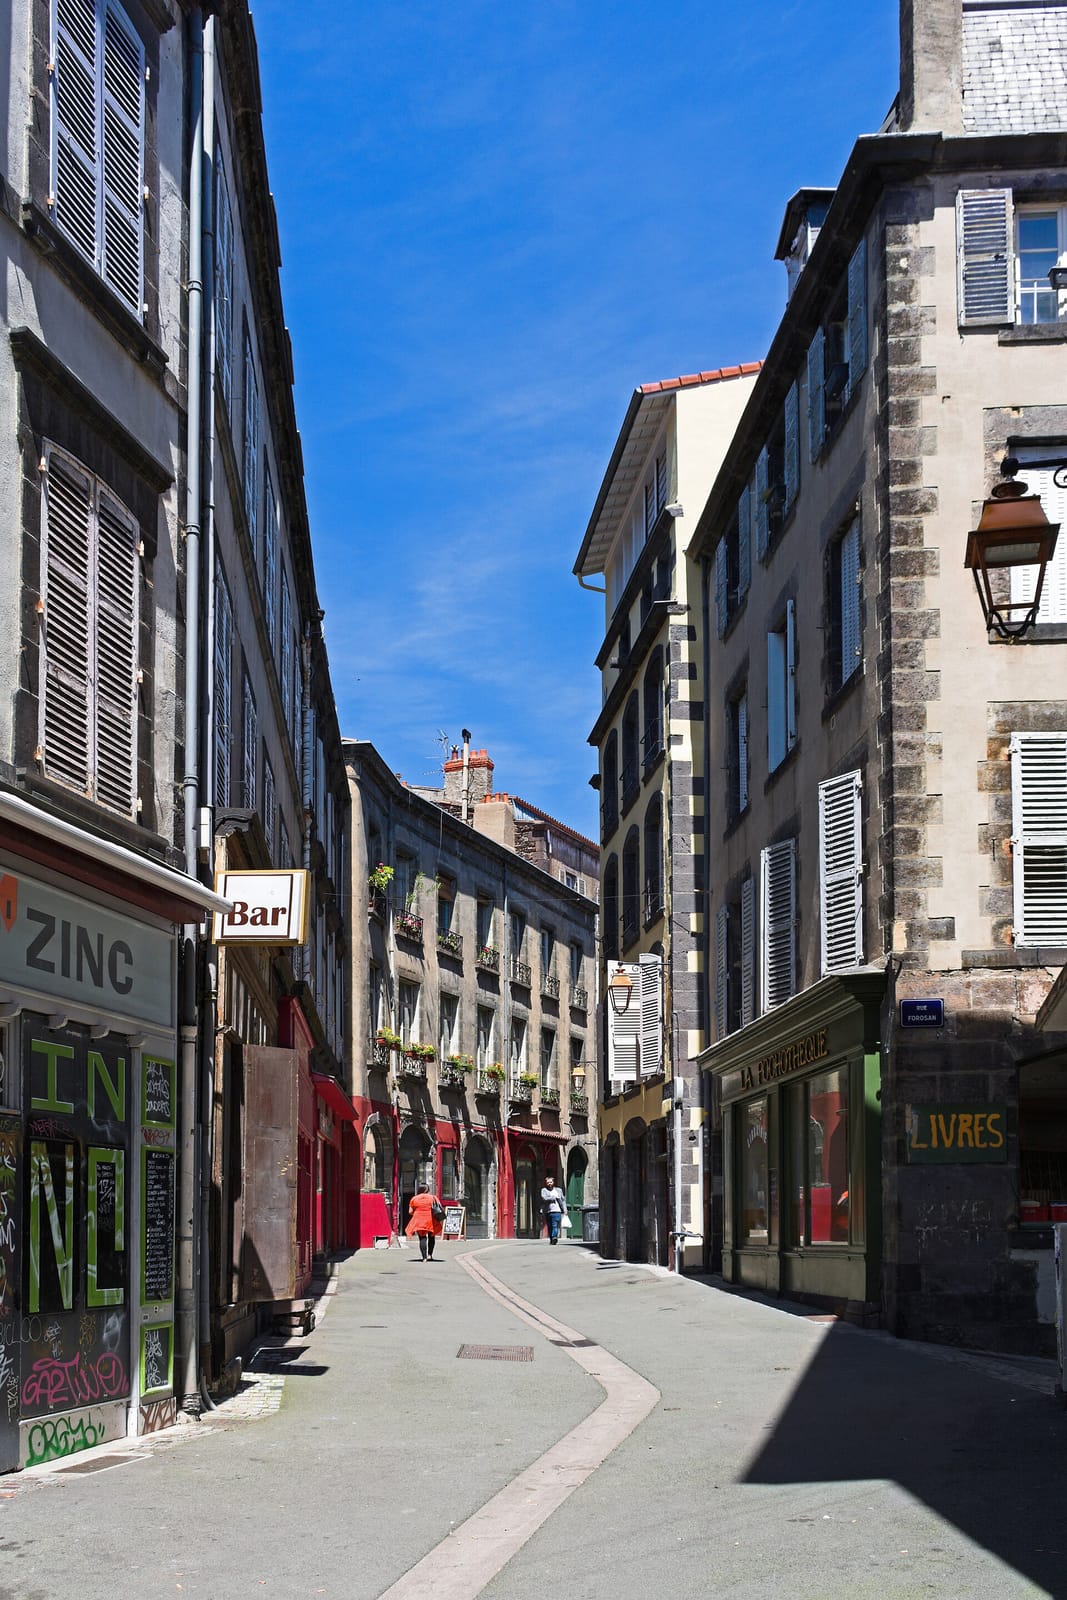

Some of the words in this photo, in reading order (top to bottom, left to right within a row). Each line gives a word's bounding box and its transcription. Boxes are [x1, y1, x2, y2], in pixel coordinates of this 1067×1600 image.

[227, 901, 287, 927] Bar
[26, 907, 133, 995] ZINC
[741, 1066, 755, 1091] LA
[911, 1113, 1004, 1148] LIVRES
